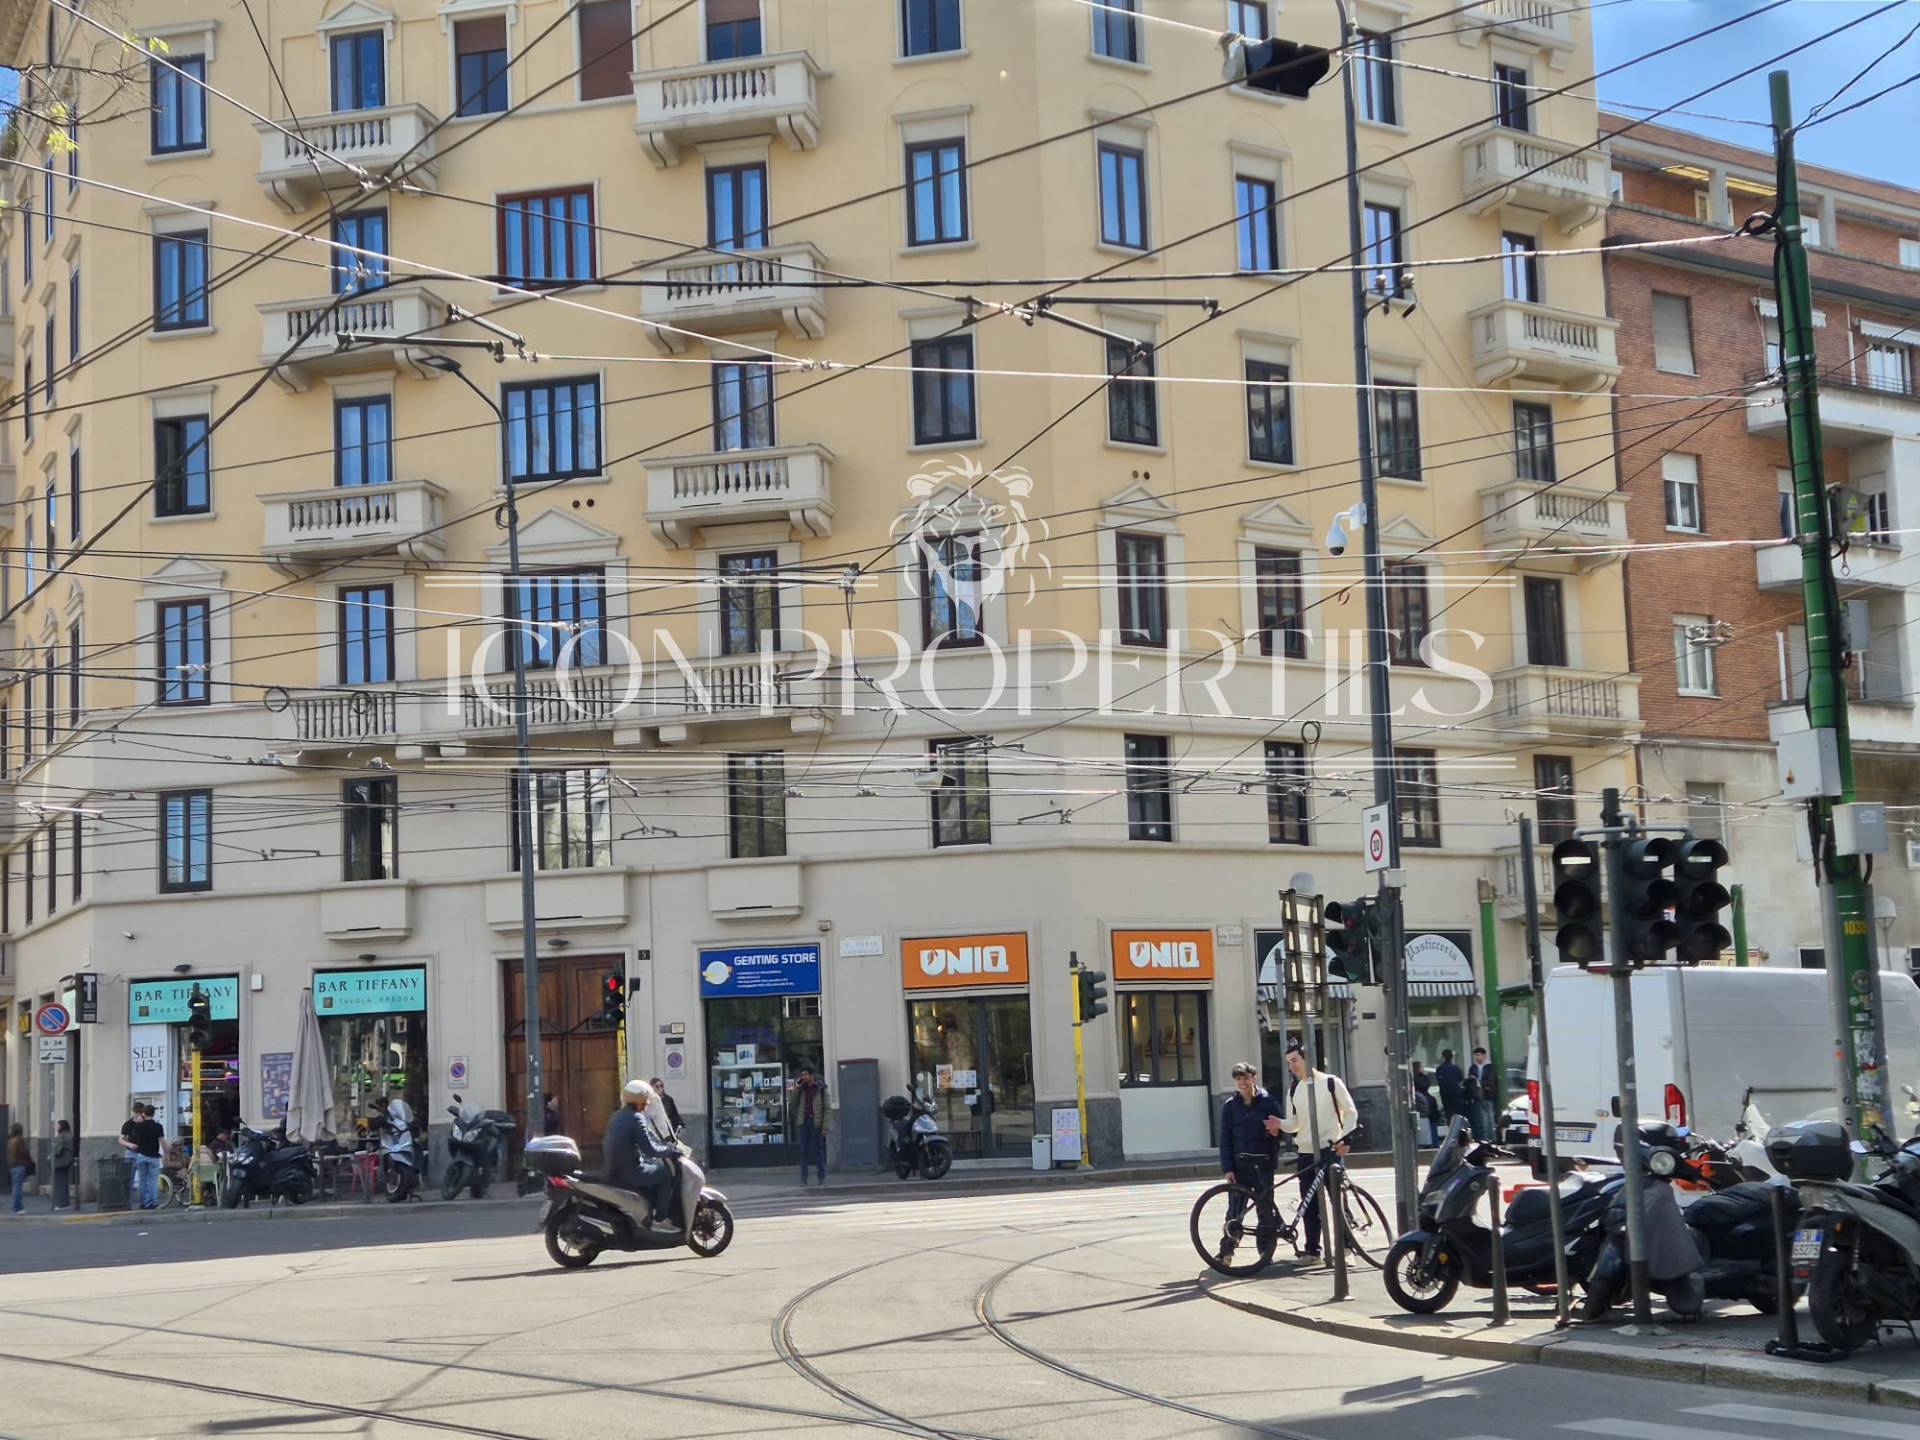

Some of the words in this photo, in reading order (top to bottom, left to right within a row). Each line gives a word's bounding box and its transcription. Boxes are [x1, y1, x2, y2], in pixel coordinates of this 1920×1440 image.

[1373, 838, 1380, 852] 30
[734, 954, 779, 966] GENTING
[781, 953, 817, 963] STORE
[919, 945, 1009, 976] UNIQ
[1128, 941, 1200, 968] UNIQ
[318, 980, 348, 993] BAR
[357, 977, 419, 991] TIFFANY
[134, 990, 163, 1001] BAR
[170, 986, 233, 1000] TIFANY
[132, 1046, 165, 1059] SELF
[135, 1059, 162, 1072] H24
